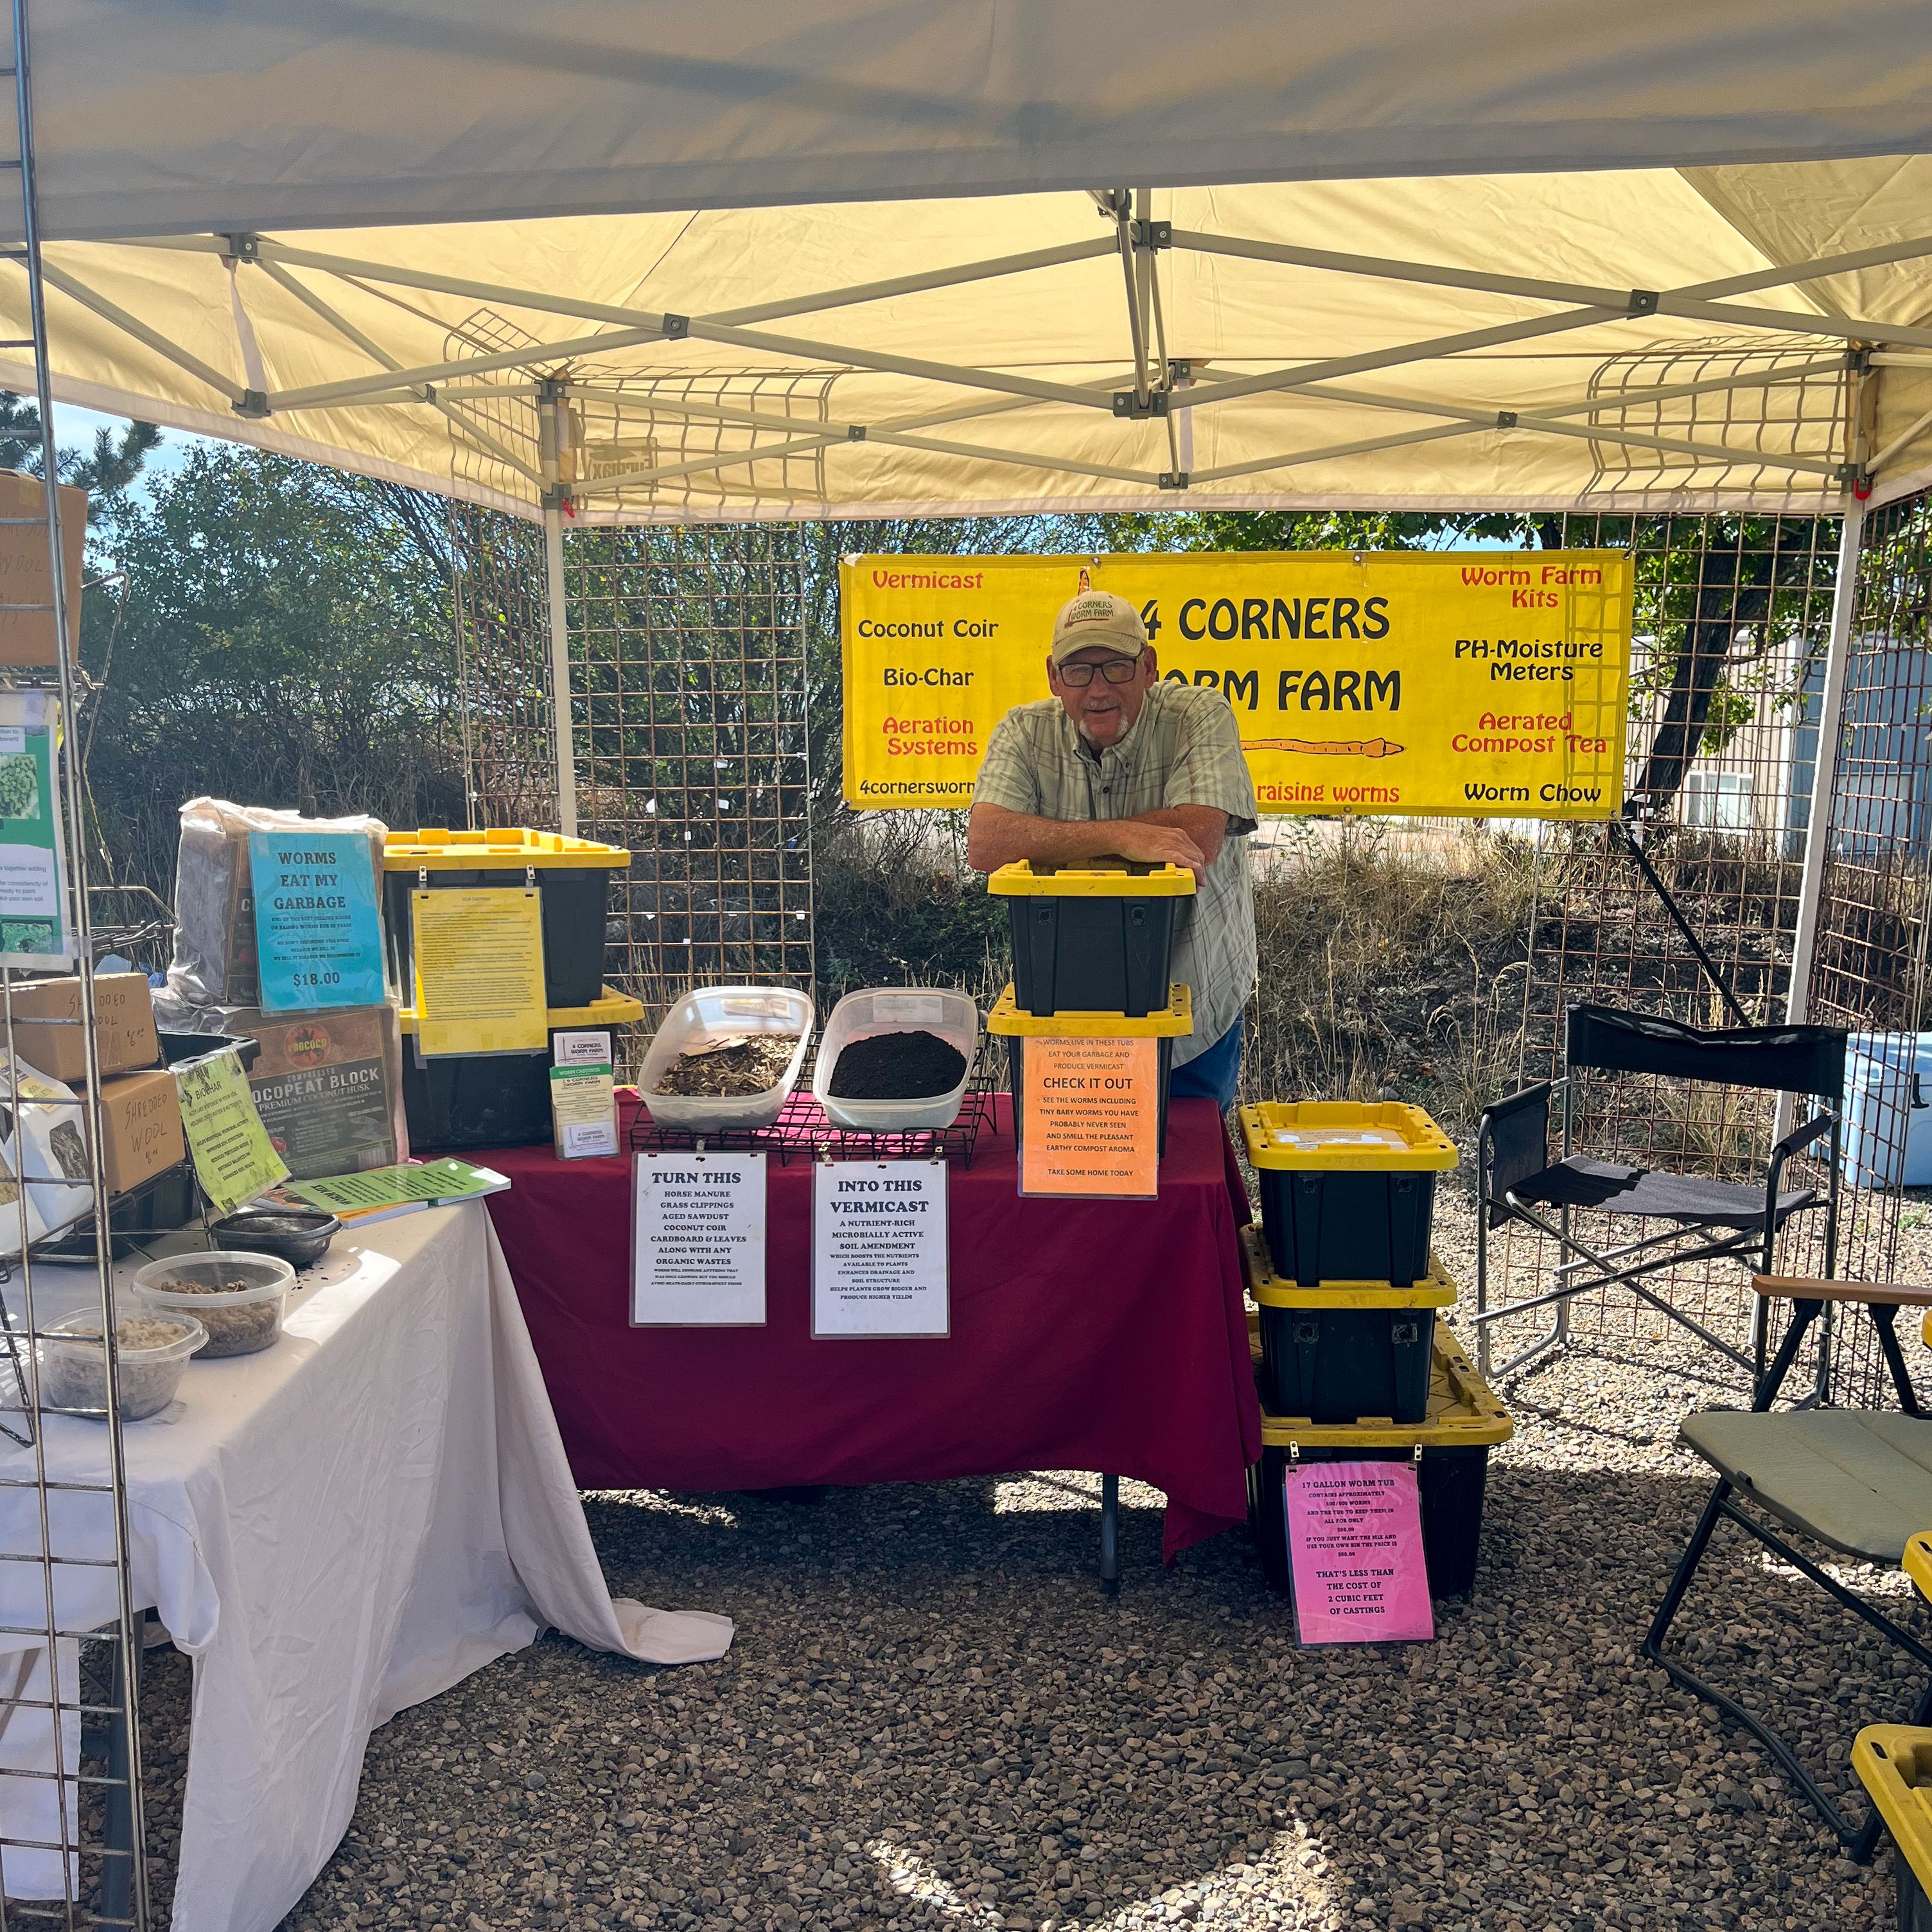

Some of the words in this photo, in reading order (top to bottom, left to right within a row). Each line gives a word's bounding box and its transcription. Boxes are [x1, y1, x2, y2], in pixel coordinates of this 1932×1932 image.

[873, 570, 983, 588] Vermicast
[1461, 567, 1530, 585] Worm
[1541, 566, 1603, 586] Farm
[1078, 601, 1112, 610] CORNERS
[1512, 589, 1558, 607] Kits
[1071, 609, 1092, 620] WORM
[1094, 609, 1114, 617] FARM
[1141, 600, 1162, 640] 4
[1179, 598, 1390, 641] CORNERS
[858, 620, 944, 637] Coconut
[954, 619, 998, 637] Coir
[1455, 638, 1603, 659] PH-Moisture
[884, 668, 974, 685] Bio-Char
[1491, 662, 1573, 680] Meters
[1278, 670, 1400, 710] FARM
[883, 716, 973, 733] Aeration
[1479, 712, 1573, 731] Aerated
[888, 737, 977, 755] Systems
[1452, 734, 1555, 752] Compost
[1566, 735, 1606, 753] Tea
[1257, 781, 1324, 801] raising
[1333, 787, 1399, 802] worms
[1464, 784, 1529, 800] Worm
[1540, 784, 1601, 802] Chow
[277, 852, 336, 864] WORMS
[280, 874, 310, 886] EAT
[314, 874, 337, 886] MY
[274, 896, 345, 909] GARBAGE
[294, 972, 339, 987] $18.00
[195, 1081, 222, 1100] BIOCHAR
[252, 1078, 323, 1103] OCOPEAT
[329, 1067, 379, 1088] BLOCK
[1043, 1077, 1085, 1088] CHECK
[1089, 1078, 1100, 1088] IT
[1105, 1078, 1132, 1089] OUT
[259, 1098, 301, 1111] PREMIUM
[347, 1084, 370, 1094] HUSK
[131, 1123, 168, 1153] WOOL
[652, 1172, 698, 1183] TURN
[703, 1172, 741, 1183] THIS
[838, 1181, 879, 1191] INTO
[883, 1180, 922, 1191] THIS
[830, 1200, 928, 1213] VERMICAST
